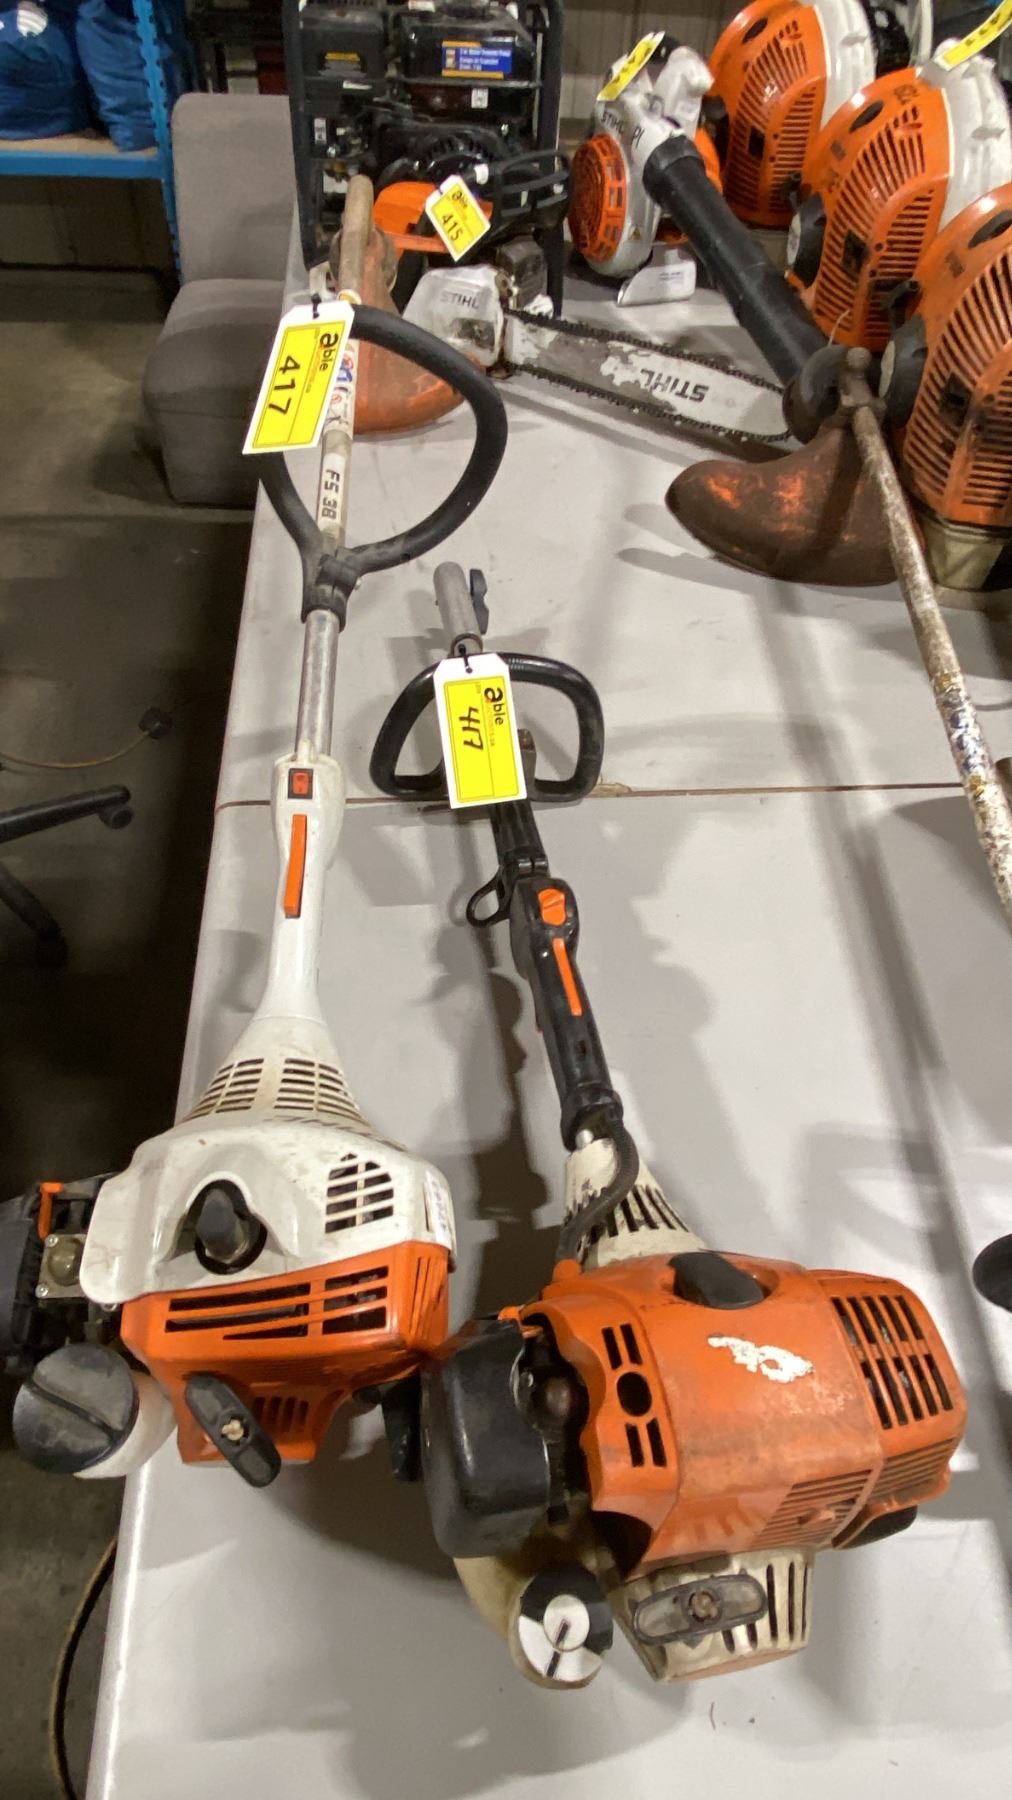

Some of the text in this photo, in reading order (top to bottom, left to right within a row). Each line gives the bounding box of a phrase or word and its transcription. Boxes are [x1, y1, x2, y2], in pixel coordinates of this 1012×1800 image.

[442, 214, 463, 241] 415
[441, 290, 480, 309] STIHL
[319, 333, 339, 371] able
[269, 355, 300, 415] 417
[640, 368, 709, 402] STIHL
[323, 469, 340, 492] FS
[484, 687, 506, 726] able
[459, 706, 484, 750] 417
